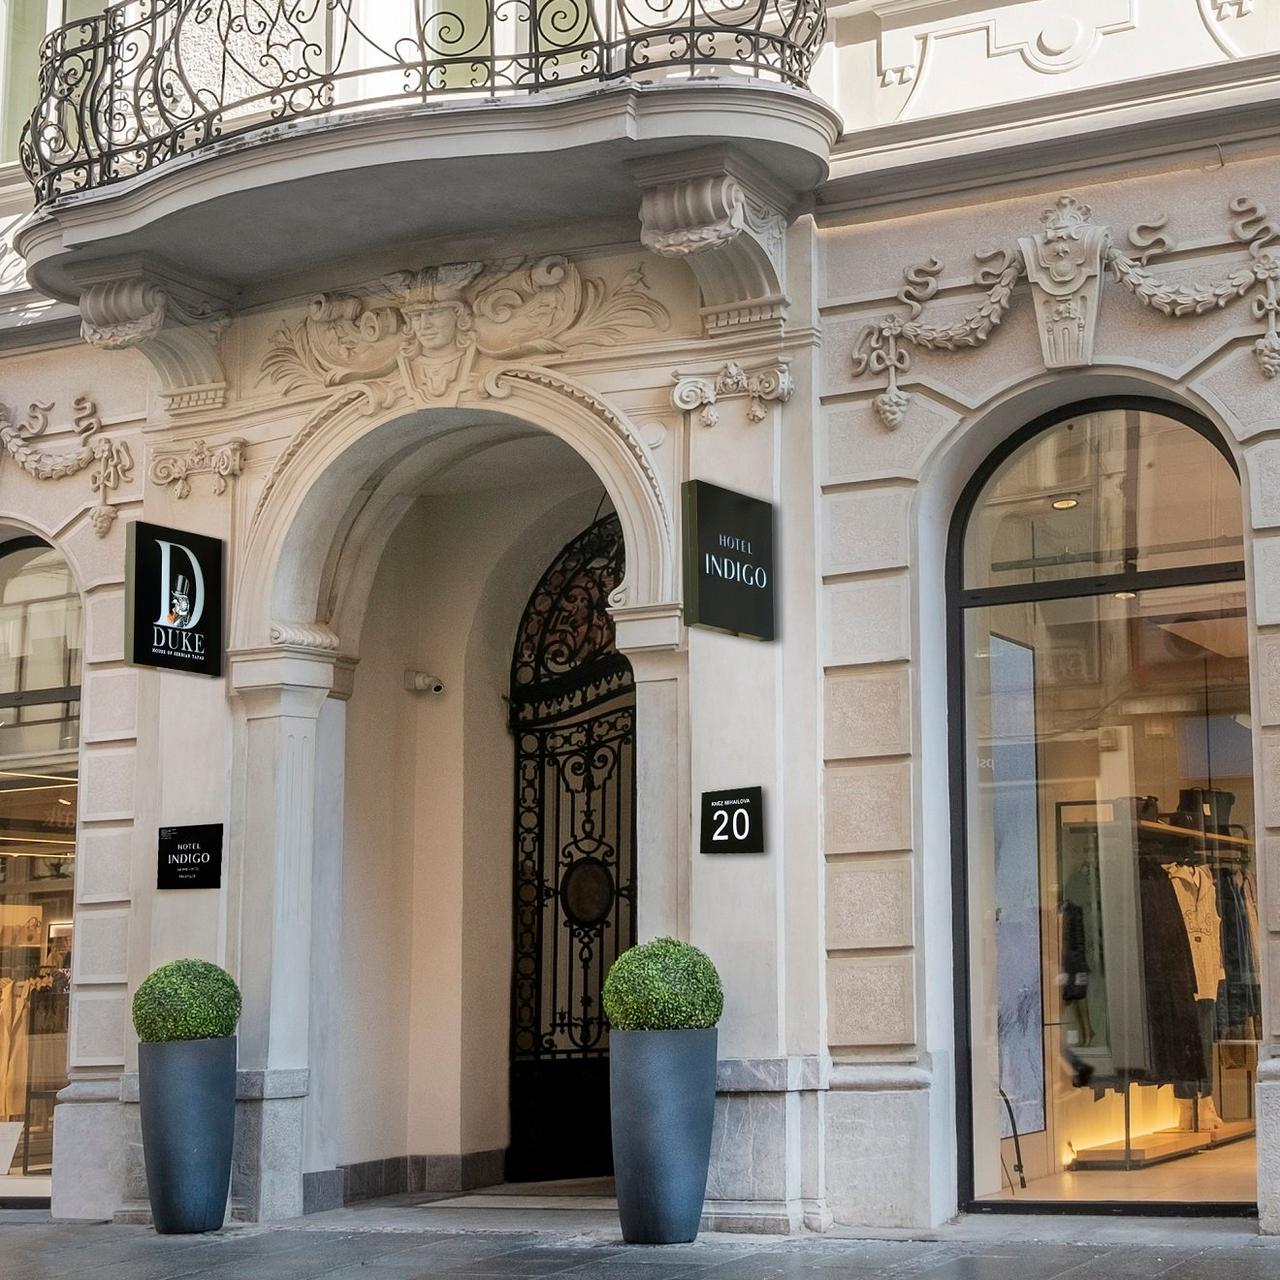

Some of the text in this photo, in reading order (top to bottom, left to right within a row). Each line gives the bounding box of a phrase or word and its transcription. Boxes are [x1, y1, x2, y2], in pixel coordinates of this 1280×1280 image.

[719, 534, 753, 555] HOTEL
[705, 553, 767, 589] INDIGO
[153, 626, 205, 654] DUKE
[712, 808, 750, 841] 20
[168, 852, 210, 864] INDIGO
